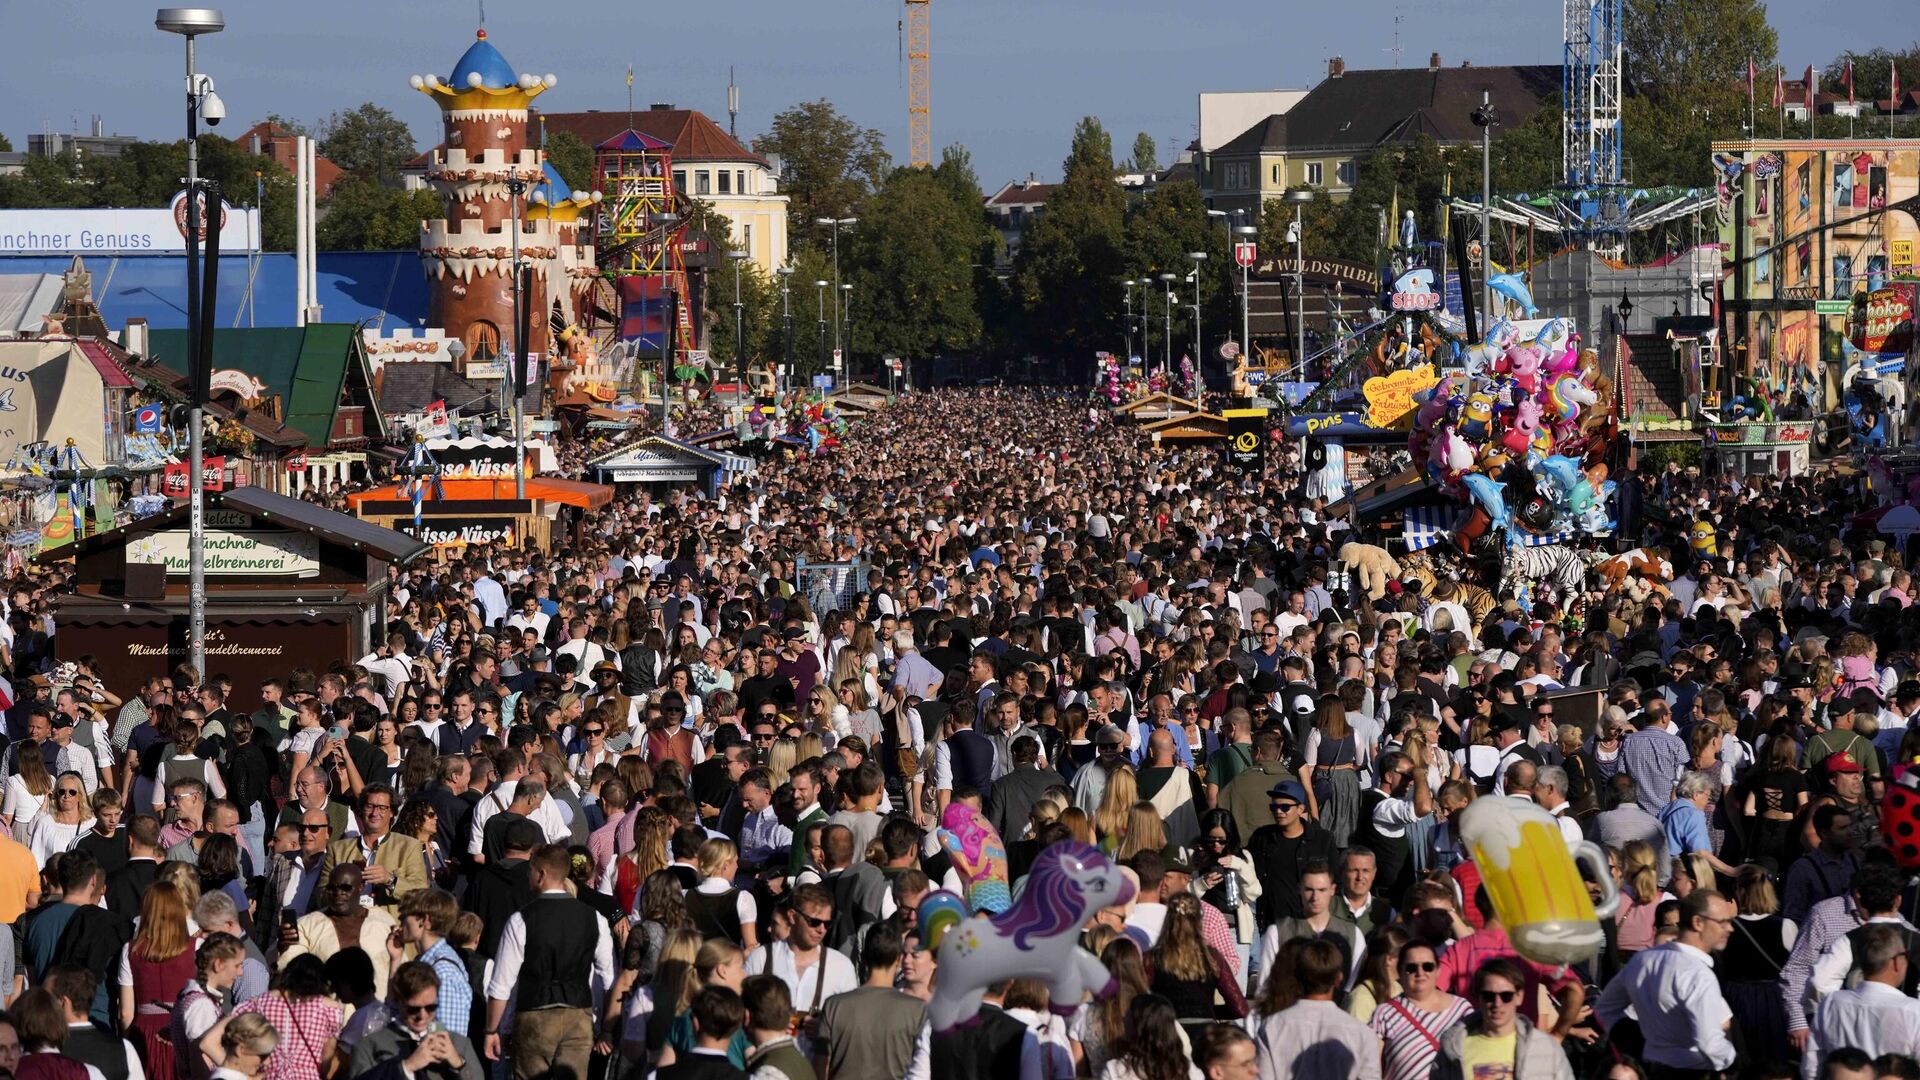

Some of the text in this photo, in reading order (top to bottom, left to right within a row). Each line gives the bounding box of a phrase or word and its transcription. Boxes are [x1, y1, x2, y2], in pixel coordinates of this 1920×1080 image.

[0, 230, 152, 249] nchner Genuss
[1392, 292, 1440, 310] SHOP
[1306, 414, 1342, 435] Pins
[187, 537, 260, 550] ünchner
[163, 555, 285, 569] Manelbrennerei
[187, 643, 283, 656] andelbrennerei
